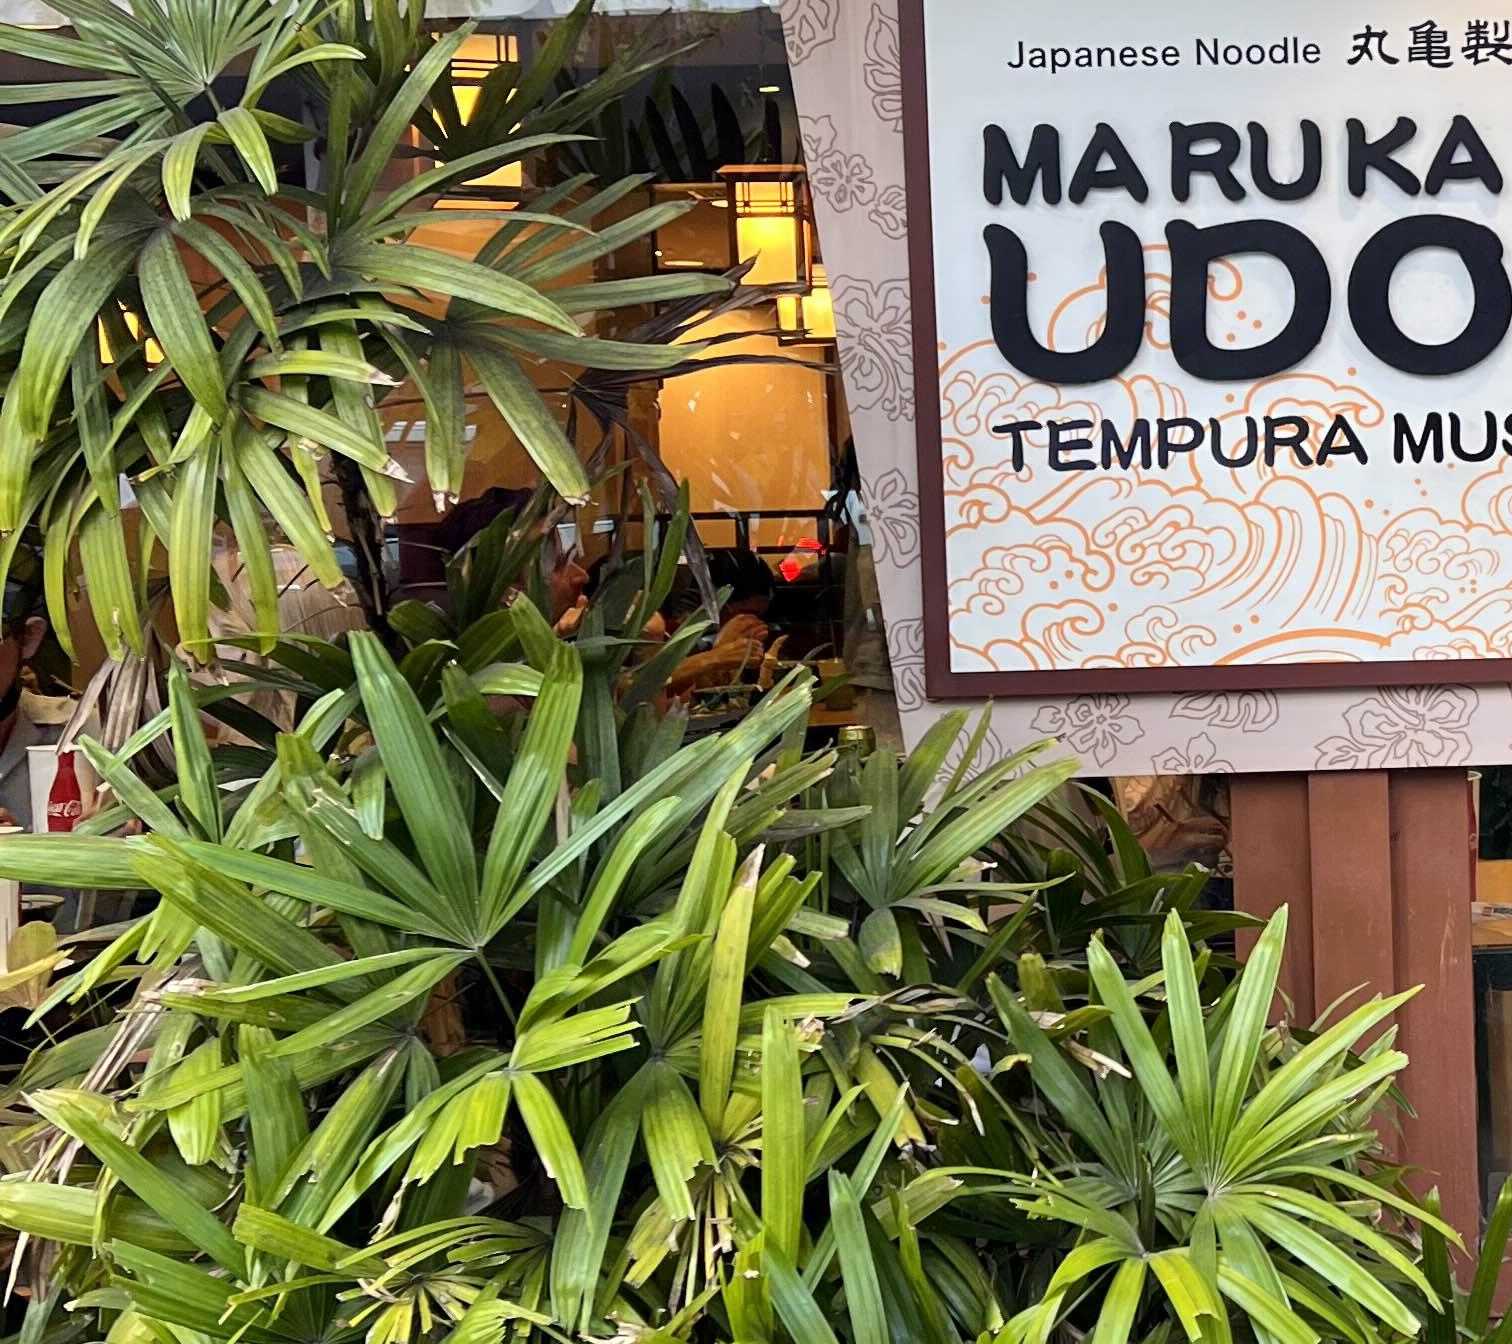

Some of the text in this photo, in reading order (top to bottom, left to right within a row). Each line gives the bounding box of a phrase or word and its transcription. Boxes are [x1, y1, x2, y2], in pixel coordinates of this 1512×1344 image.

[1007, 36, 1322, 75] Japanese Noodle
[992, 414, 1368, 473] TEMPURA
